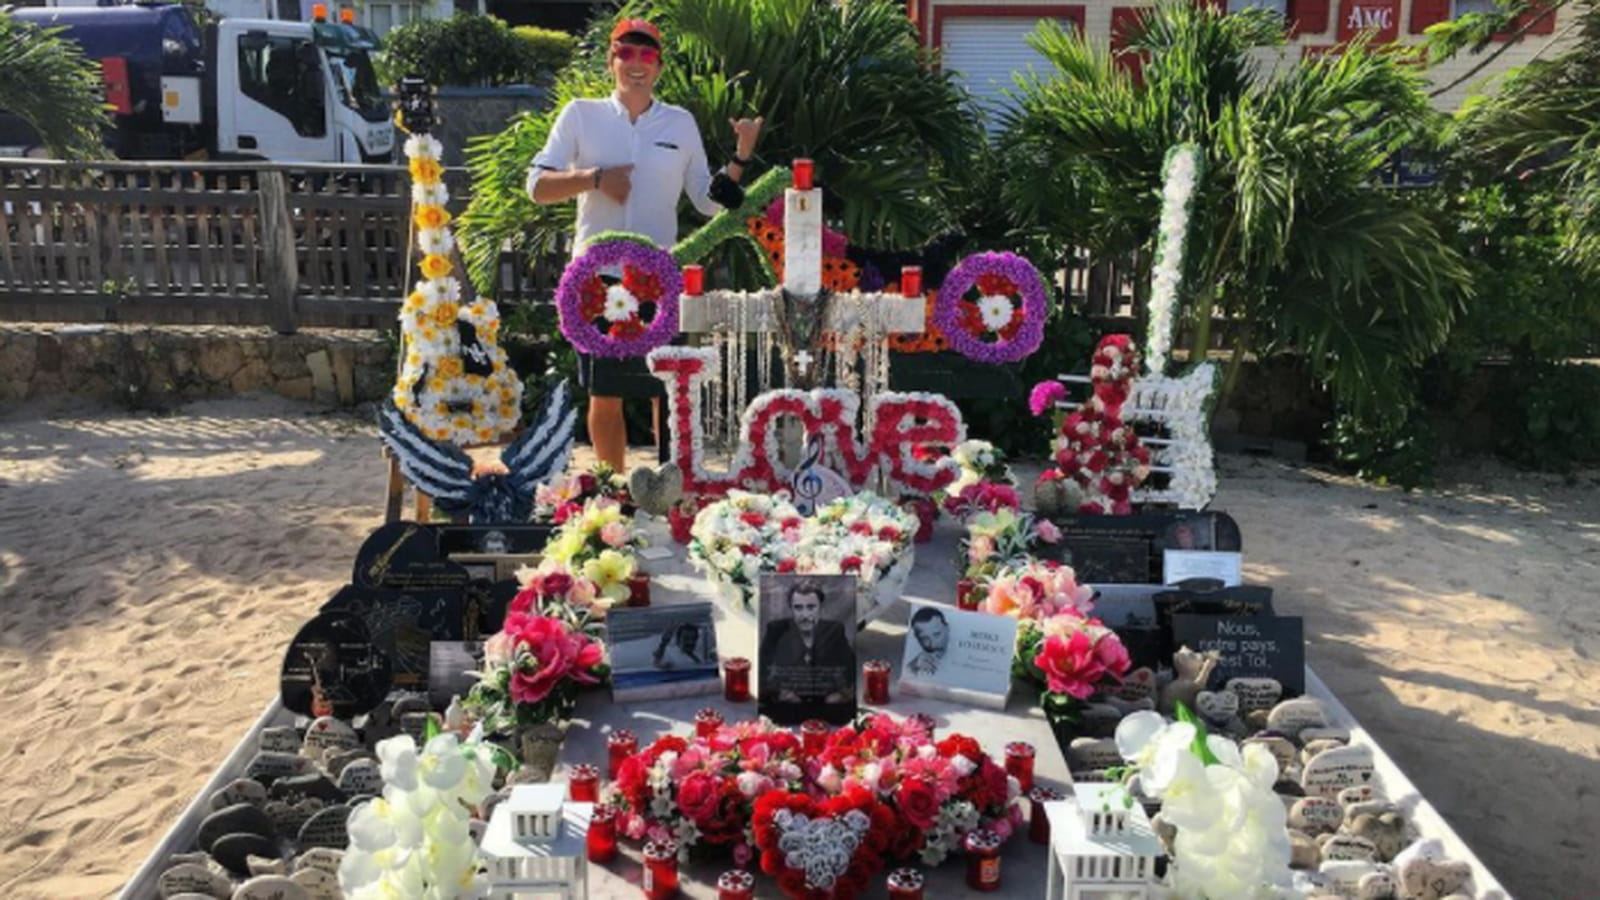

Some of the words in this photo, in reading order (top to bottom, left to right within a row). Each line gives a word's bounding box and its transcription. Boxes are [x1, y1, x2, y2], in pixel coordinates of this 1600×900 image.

[1347, 5, 1393, 30] AMC
[646, 346, 966, 498] Love
[1217, 620, 1261, 637] Nous,
[1199, 637, 1238, 652] notre
